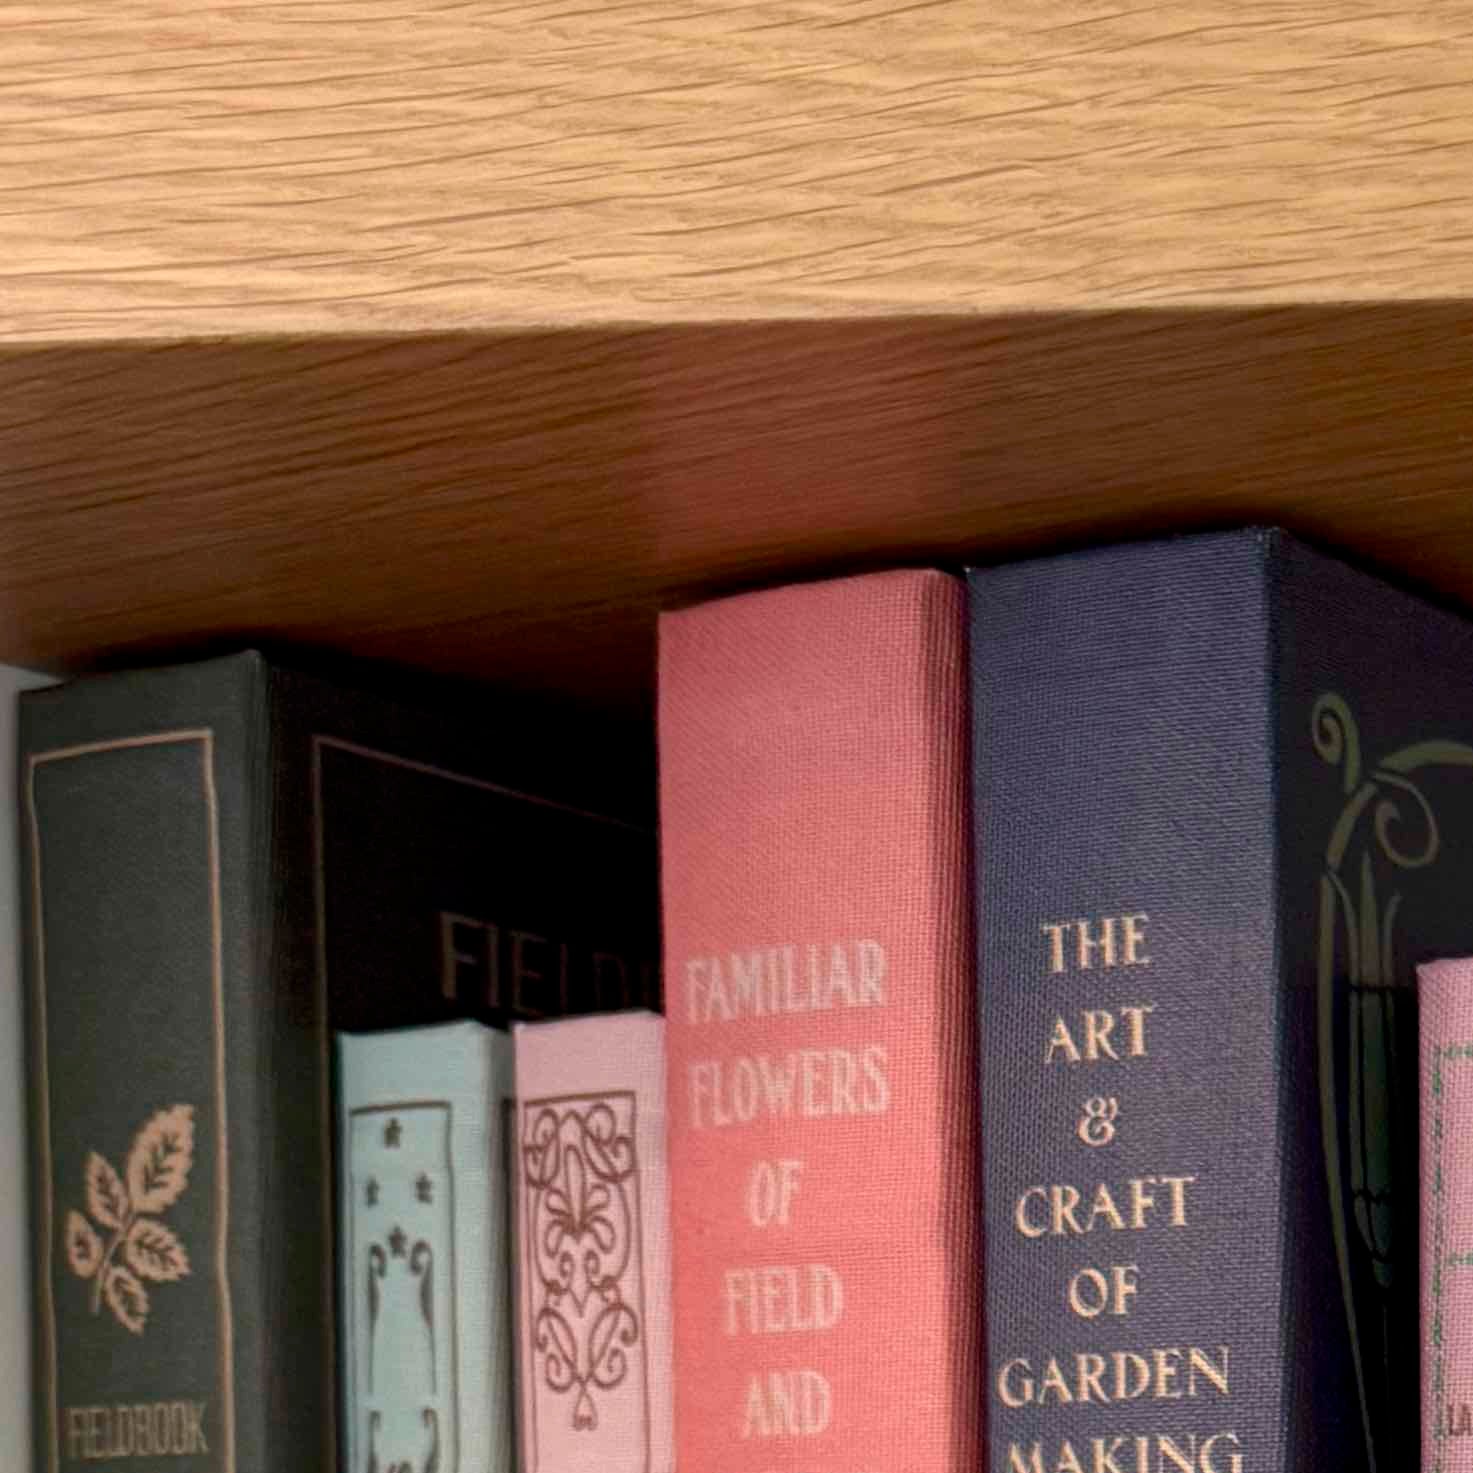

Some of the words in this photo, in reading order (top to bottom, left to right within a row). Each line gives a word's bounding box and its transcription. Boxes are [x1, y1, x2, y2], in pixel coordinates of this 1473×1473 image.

[1042, 914, 1151, 974] THE
[686, 939, 889, 1025] FAMILIAR
[1044, 1002, 1157, 1065] ART
[687, 1046, 890, 1130] FLOWERS
[1077, 1096, 1119, 1147] &
[746, 1160, 804, 1228] OF
[1015, 1175, 1196, 1239] CRAFT
[724, 1264, 844, 1337] FIELD
[1070, 1263, 1141, 1318] OF
[742, 1370, 832, 1440] AND
[999, 1345, 1231, 1408] GARDEN
[66, 1402, 209, 1459] FIELDBOOK
